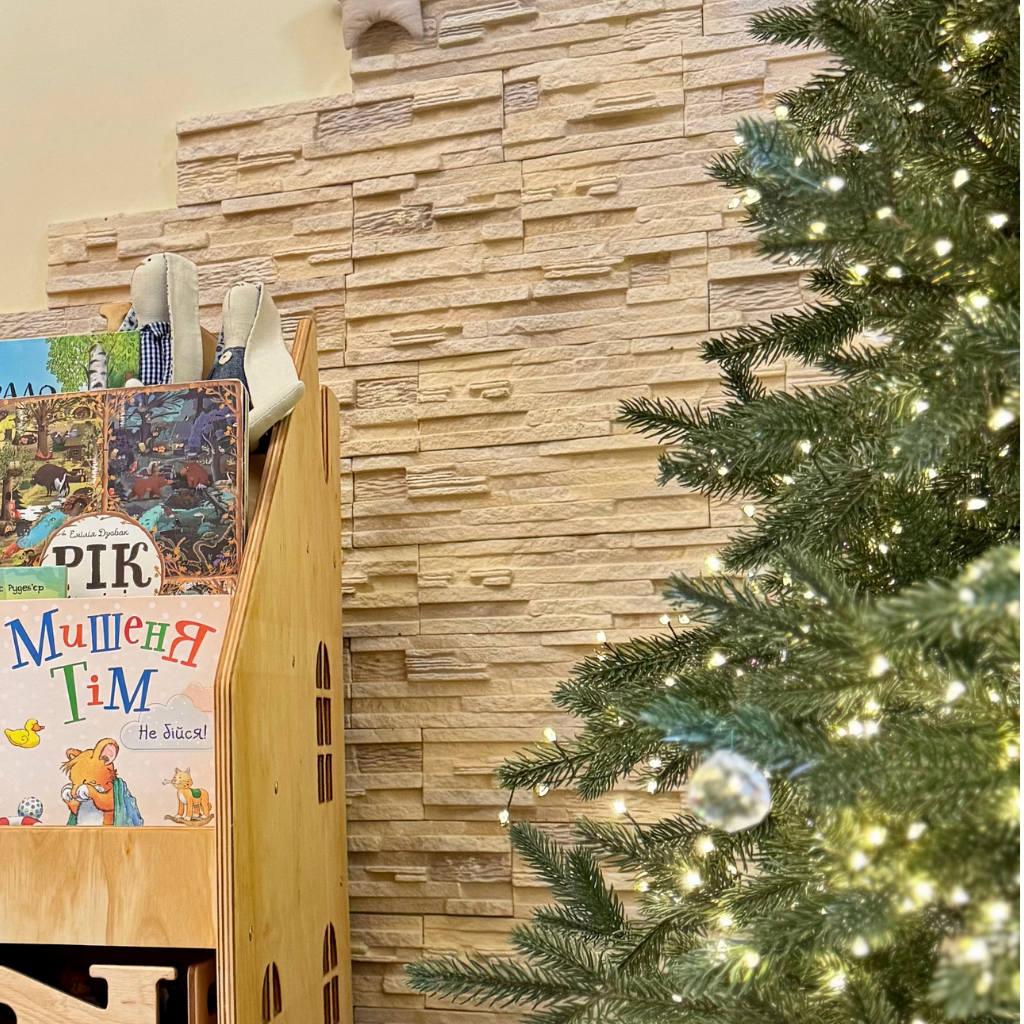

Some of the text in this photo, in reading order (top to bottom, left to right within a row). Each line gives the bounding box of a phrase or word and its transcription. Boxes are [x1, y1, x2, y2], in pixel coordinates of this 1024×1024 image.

[52, 541, 152, 590] РІК
[138, 723, 207, 741] Не бійся!
